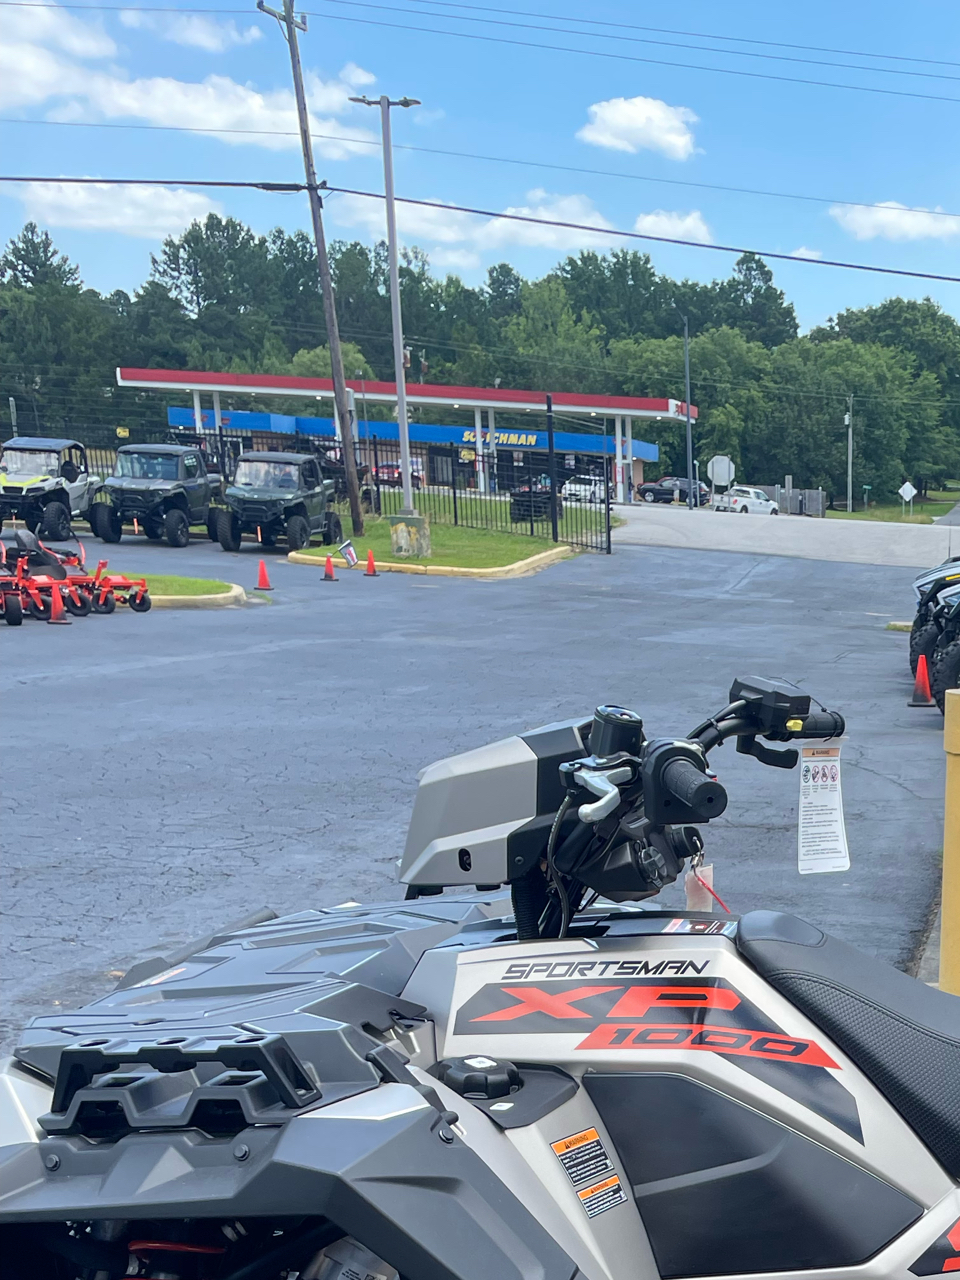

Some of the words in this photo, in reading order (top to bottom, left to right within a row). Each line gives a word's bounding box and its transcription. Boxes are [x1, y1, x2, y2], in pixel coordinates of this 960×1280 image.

[501, 959, 711, 980] SPORTSMAN
[468, 986, 741, 1022] XP
[608, 1028, 809, 1056] 1000
